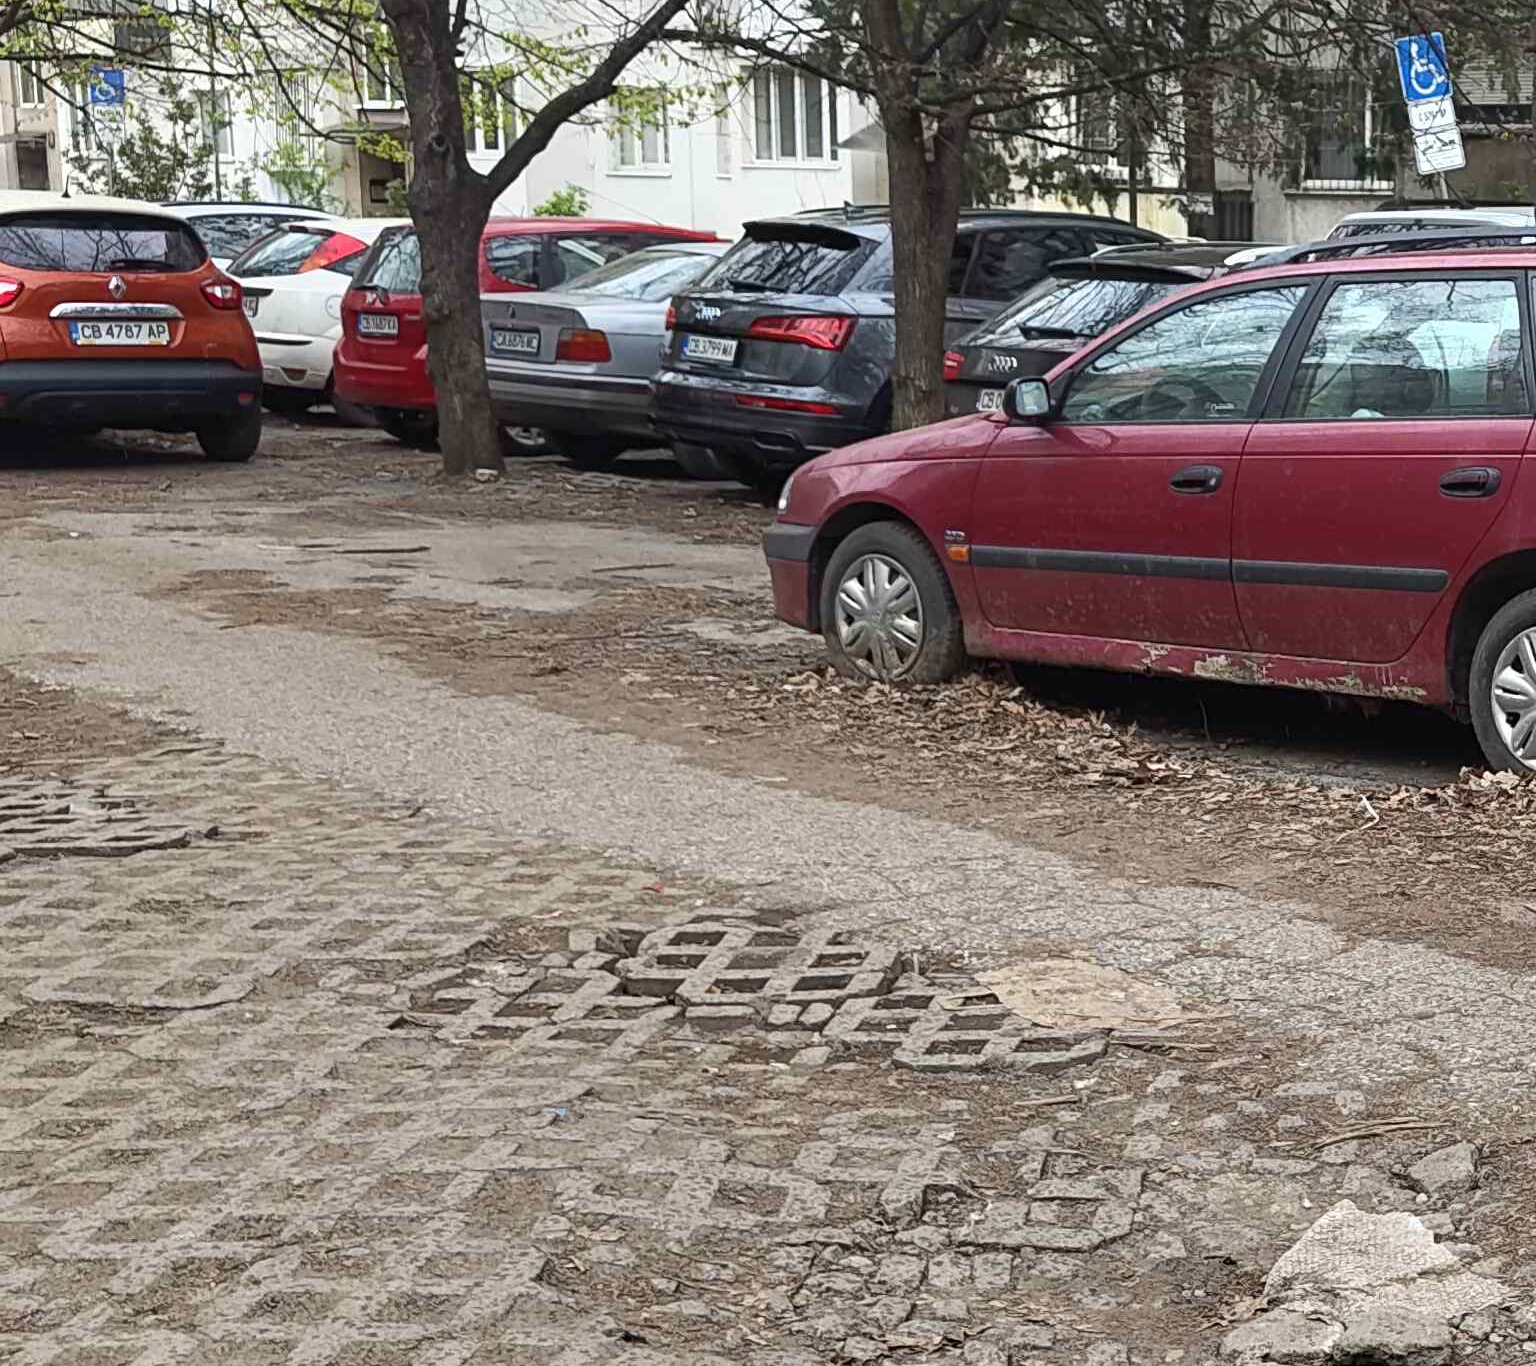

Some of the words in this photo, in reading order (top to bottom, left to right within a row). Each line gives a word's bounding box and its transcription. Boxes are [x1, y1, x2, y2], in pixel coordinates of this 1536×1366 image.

[81, 324, 102, 339] CB
[105, 324, 142, 339] 4787
[148, 324, 166, 339] AP
